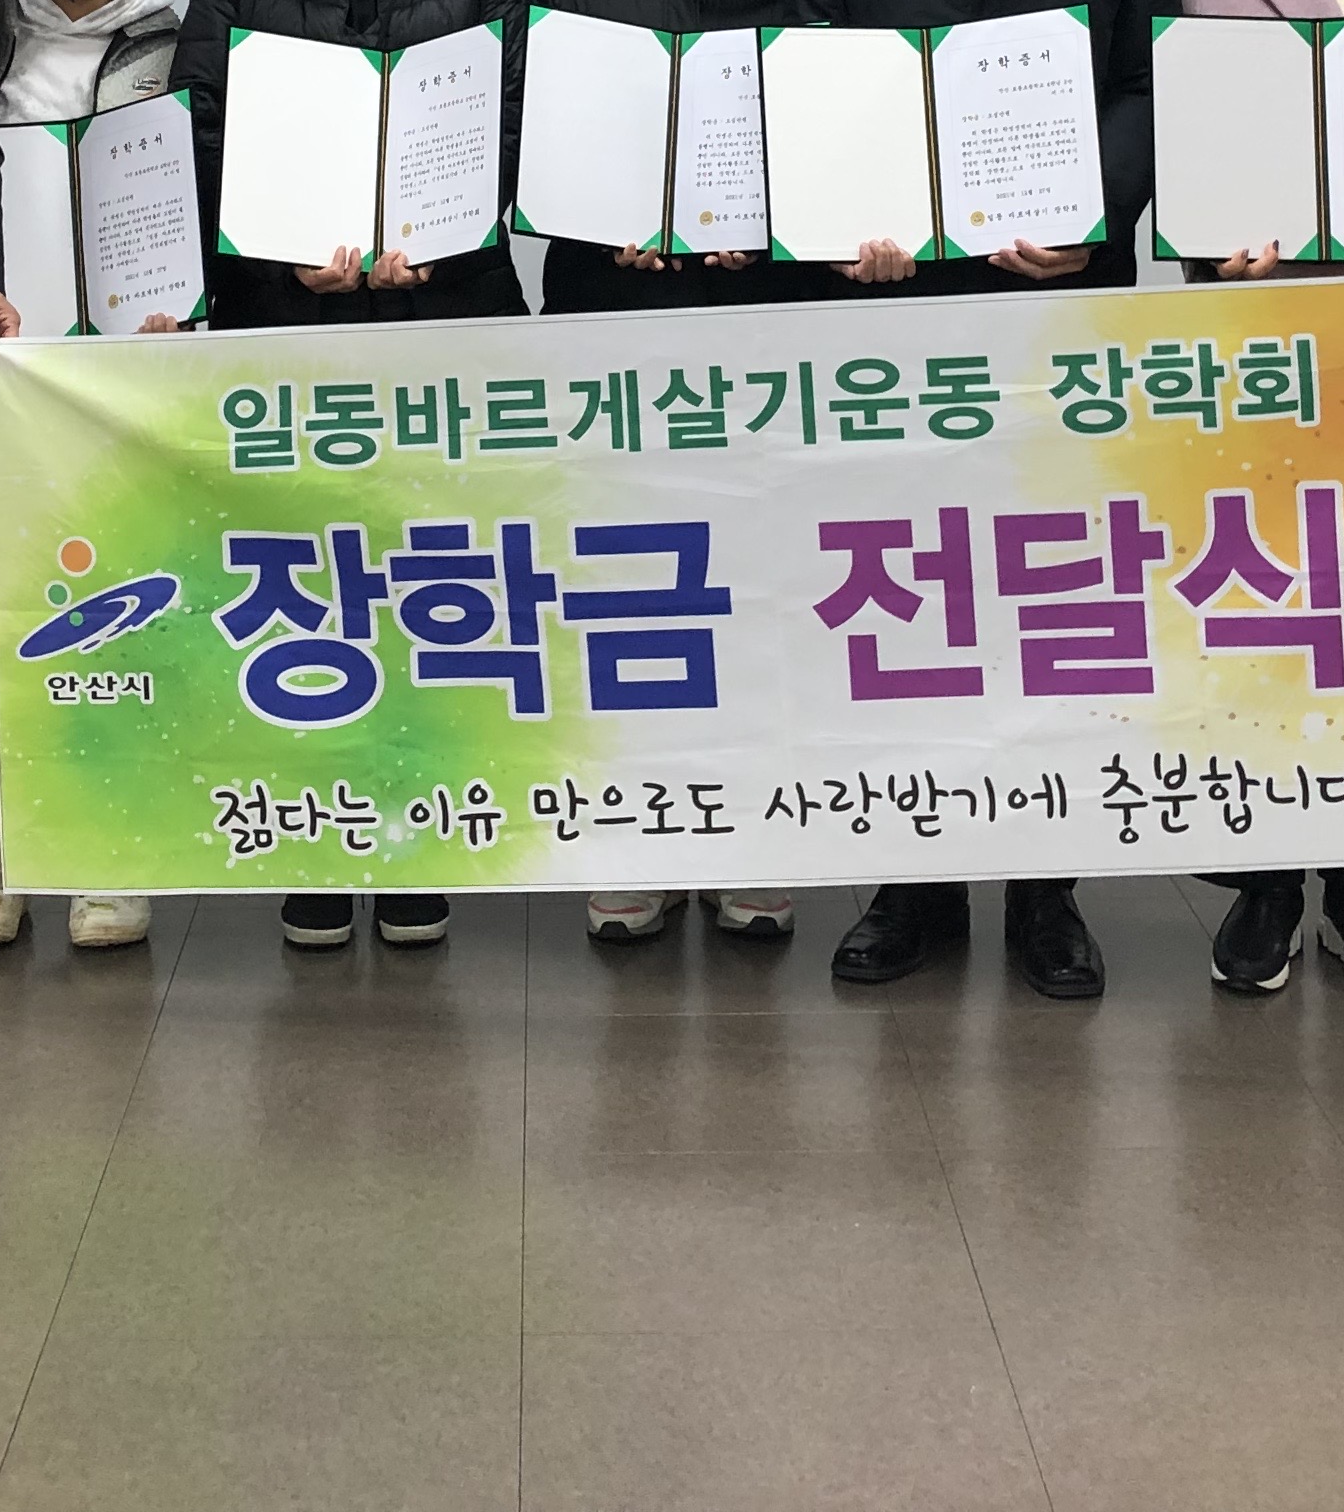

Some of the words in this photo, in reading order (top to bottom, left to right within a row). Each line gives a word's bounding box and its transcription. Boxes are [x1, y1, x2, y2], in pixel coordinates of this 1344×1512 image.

[223, 355, 1001, 468] 일동바르게살기운동
[1049, 337, 1318, 434] 장학회
[220, 522, 732, 723] 장학금
[47, 672, 153, 703] 안산시
[215, 782, 378, 854] 젊다는
[408, 786, 502, 846] 이유
[534, 781, 735, 840] 만으로도
[764, 770, 1067, 838] 사랑받기에
